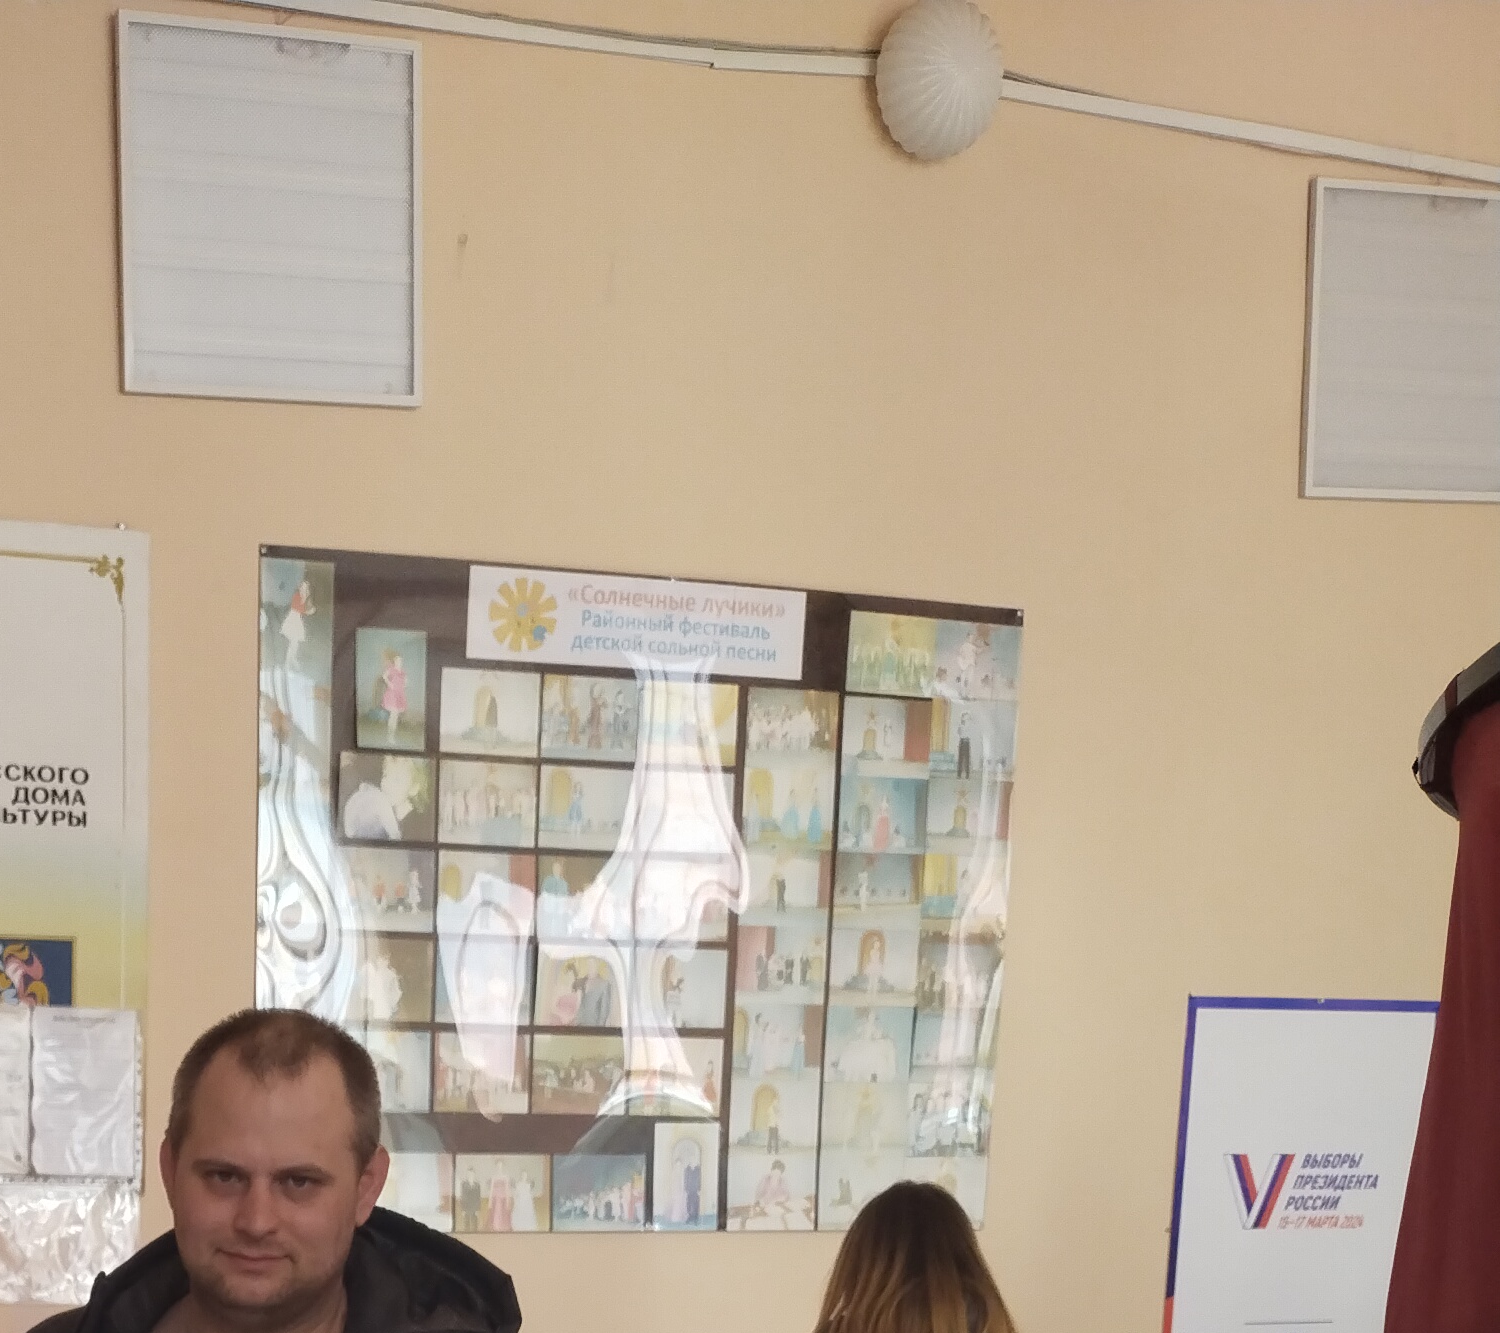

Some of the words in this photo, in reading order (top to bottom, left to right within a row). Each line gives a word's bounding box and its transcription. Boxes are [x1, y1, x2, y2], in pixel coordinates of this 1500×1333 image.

[568, 584, 696, 613] «Солнечные
[701, 597, 786, 619] лучики»
[581, 609, 674, 633] Районный
[679, 616, 770, 640] фестиваль
[571, 633, 642, 653] детской
[648, 640, 721, 658] сольной
[726, 645, 777, 662] песни
[11, 786, 86, 807] ДОМА
[1300, 1153, 1364, 1170] ВЫБОРЫ
[1292, 1174, 1379, 1191] ПРЕЗИДЕНТА
[1284, 1195, 1342, 1211] РОССИИ
